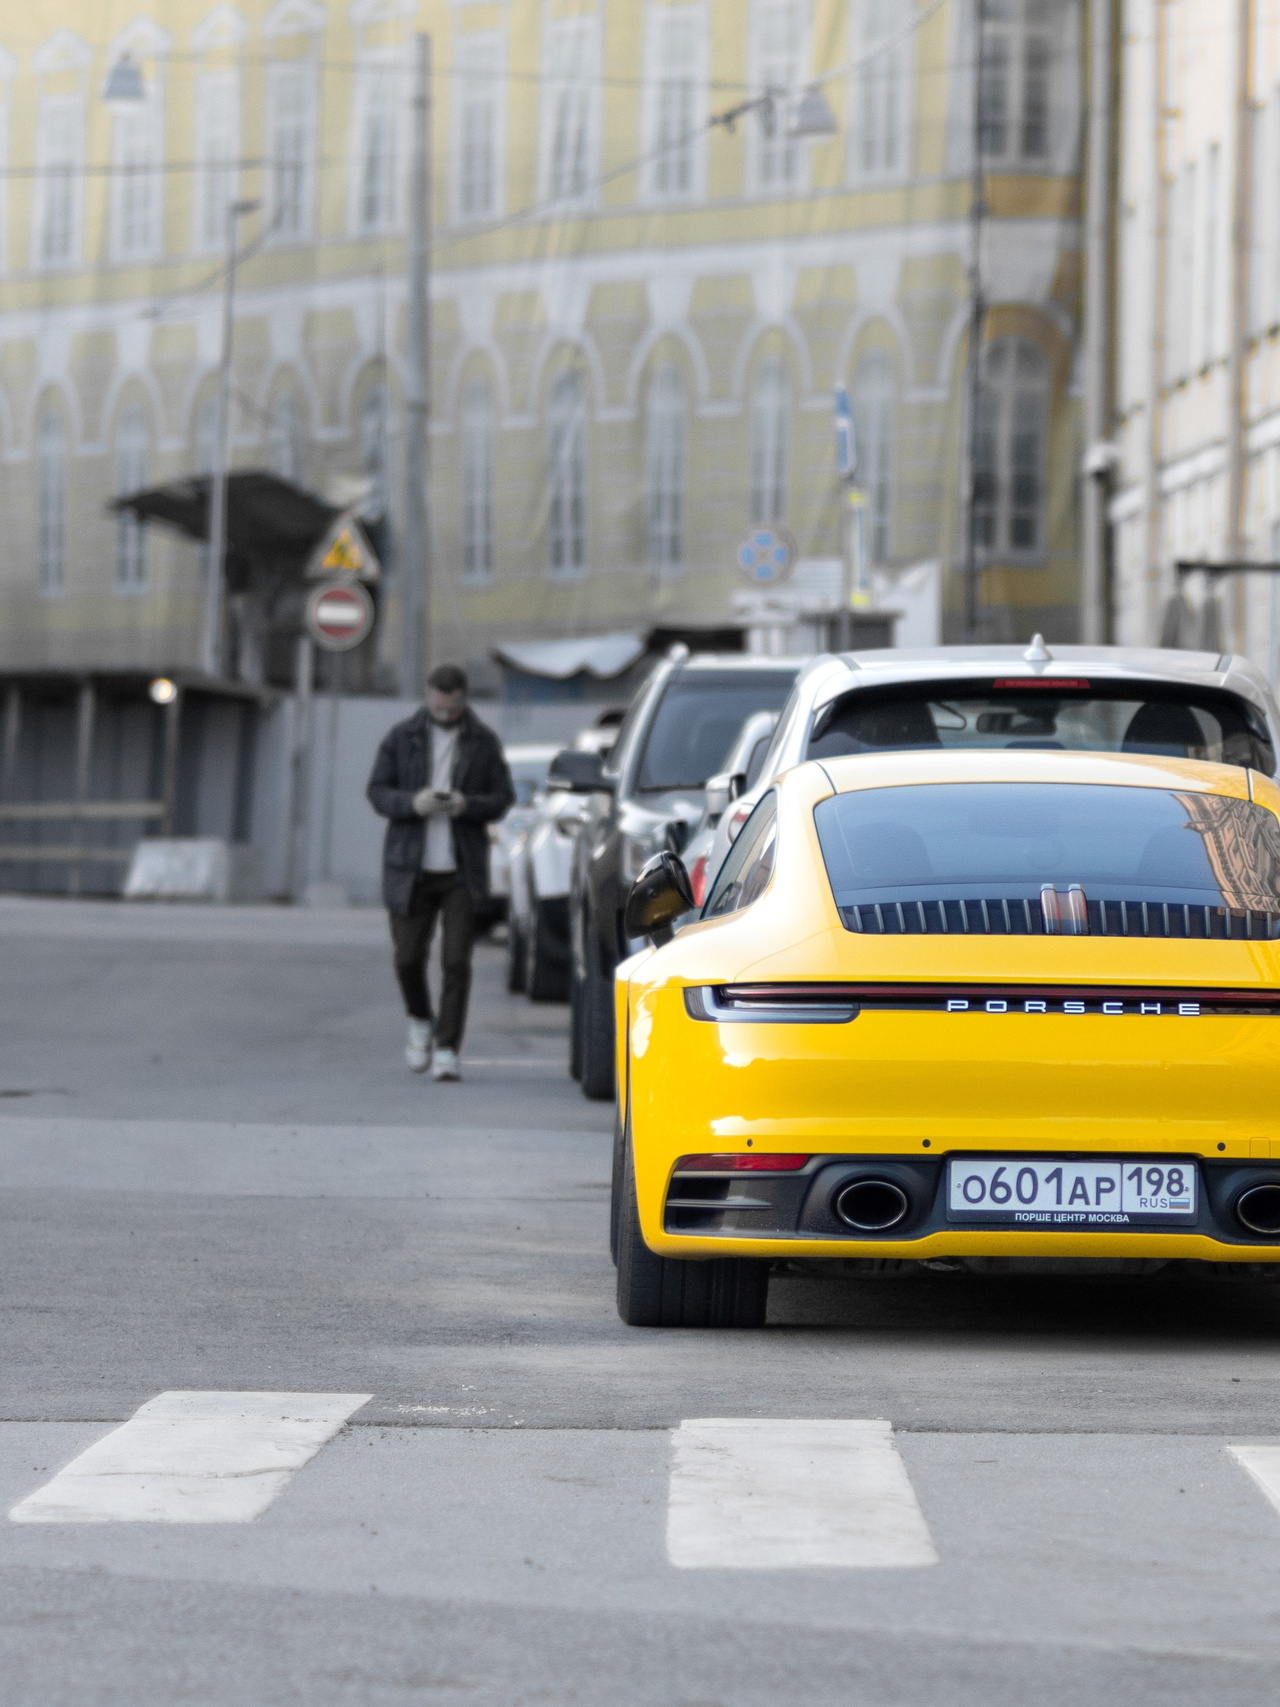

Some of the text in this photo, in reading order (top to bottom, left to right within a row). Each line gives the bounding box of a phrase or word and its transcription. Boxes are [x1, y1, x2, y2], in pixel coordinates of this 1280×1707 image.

[947, 1000, 1200, 1015] PORSCHE
[1127, 1167, 1184, 1197] 198
[1139, 1198, 1168, 1209] RUS
[1015, 1213, 1129, 1223] ПОРШЕ ЦЕНТР МОСКВА
